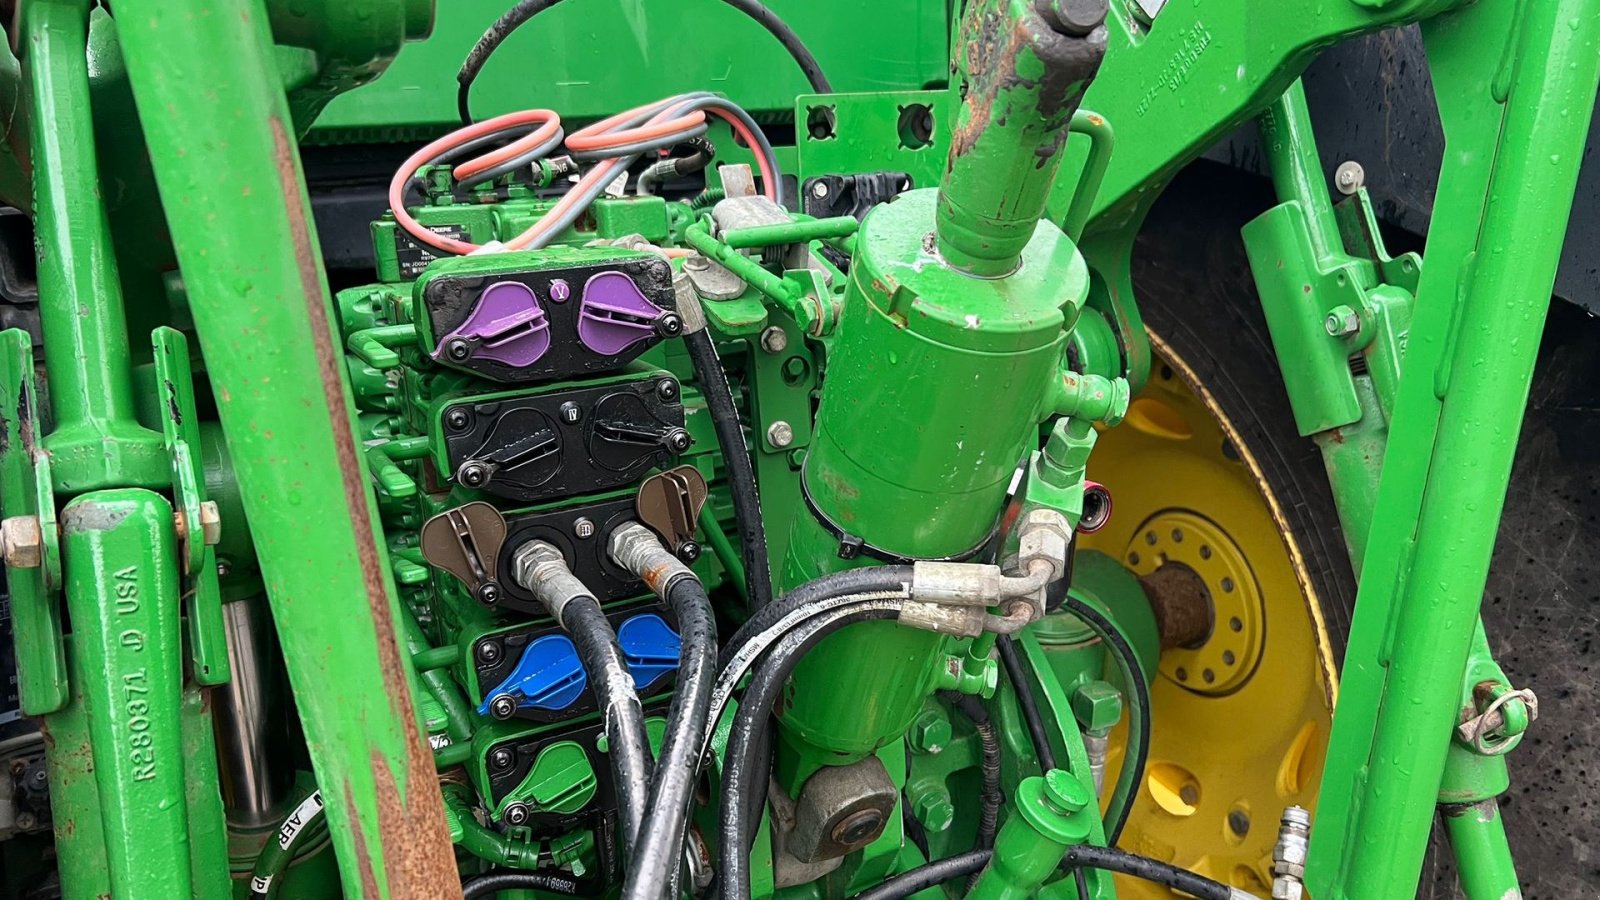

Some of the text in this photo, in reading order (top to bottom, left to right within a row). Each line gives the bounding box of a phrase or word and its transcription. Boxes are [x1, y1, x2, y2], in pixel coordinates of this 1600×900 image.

[554, 285, 565, 300] V
[568, 408, 578, 422] IV
[580, 524, 591, 537] III
[113, 565, 141, 617] USA
[122, 667, 157, 783] R280371
